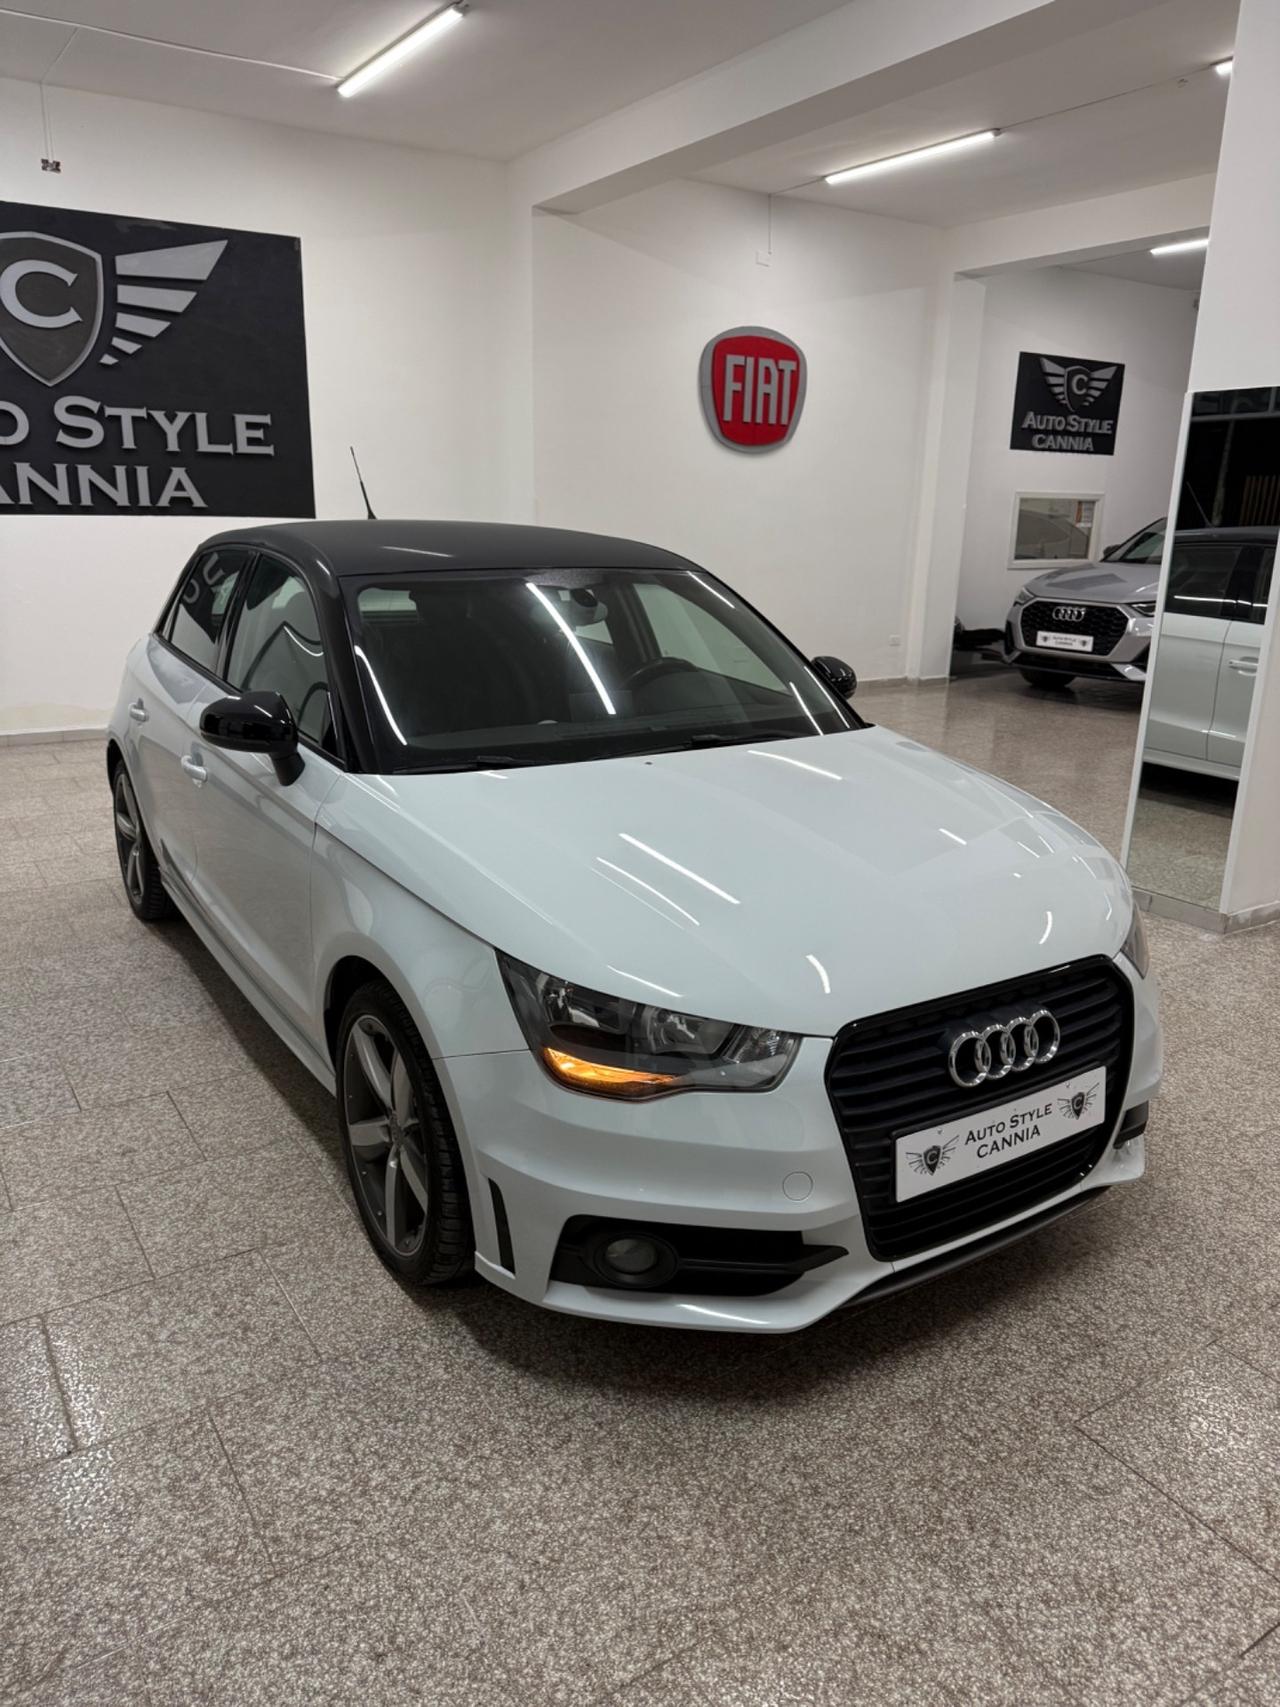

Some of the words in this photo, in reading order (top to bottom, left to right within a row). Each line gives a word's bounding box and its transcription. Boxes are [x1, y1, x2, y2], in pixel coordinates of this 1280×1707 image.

[0, 259, 83, 328] C
[722, 353, 798, 425] FIAT
[1071, 373, 1089, 395] C
[53, 395, 275, 456] STYLE
[1021, 411, 1066, 431] AUTO
[1066, 414, 1114, 434] STYLE
[1031, 434, 1094, 452] CANNIA
[964, 1121, 1006, 1145] AUTO
[1009, 1103, 1053, 1129] STYLE
[976, 1124, 1041, 1159] CANNIA
